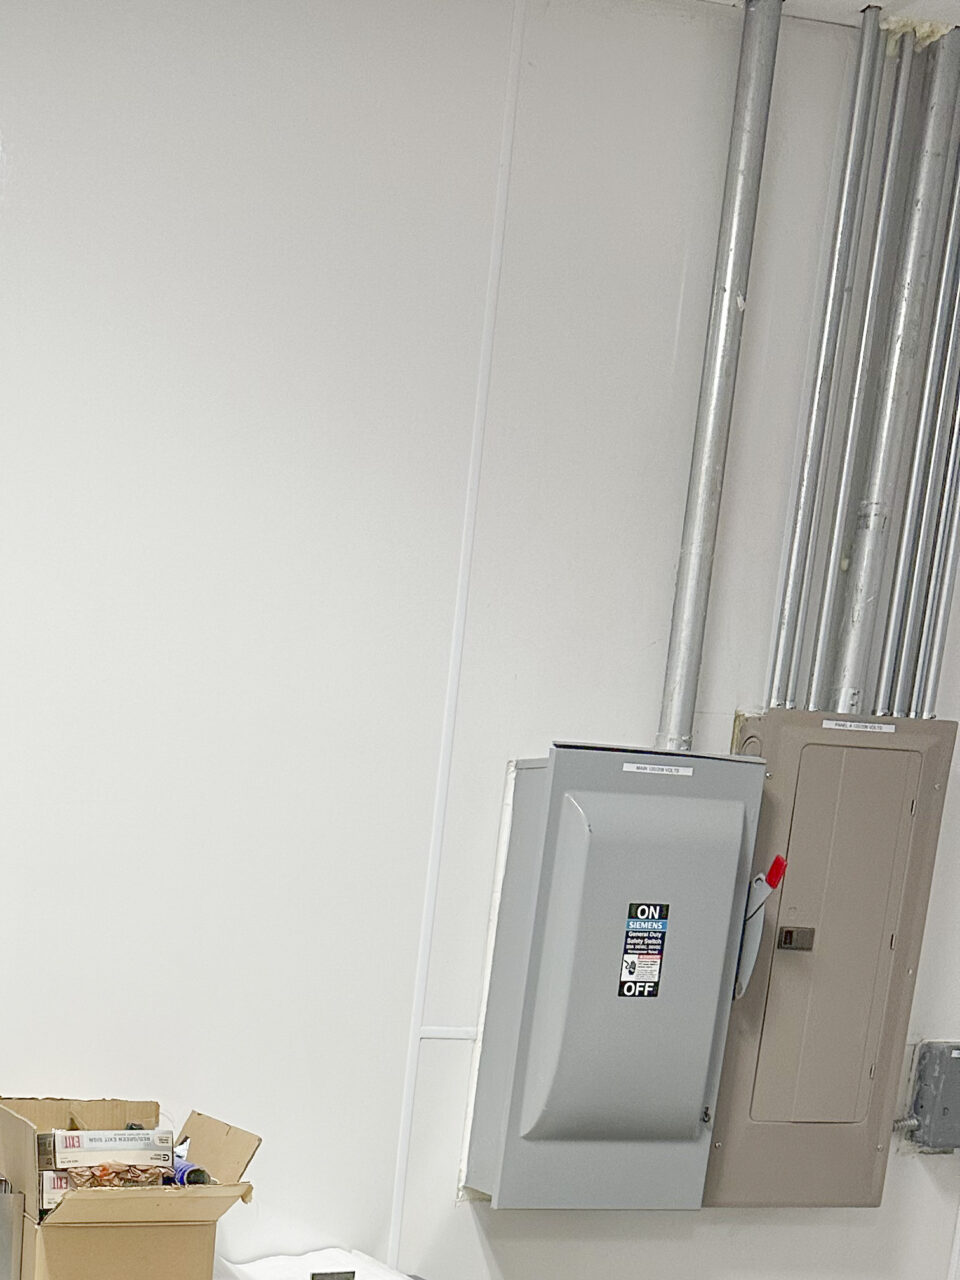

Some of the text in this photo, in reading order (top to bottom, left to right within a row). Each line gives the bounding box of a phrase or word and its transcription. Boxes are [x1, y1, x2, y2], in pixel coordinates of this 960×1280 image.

[637, 905, 659, 919] ON
[629, 921, 663, 929] SIEMENS
[623, 982, 654, 996] OFF
[64, 1135, 81, 1149] EXIT
[52, 1176, 69, 1190] EXIT
